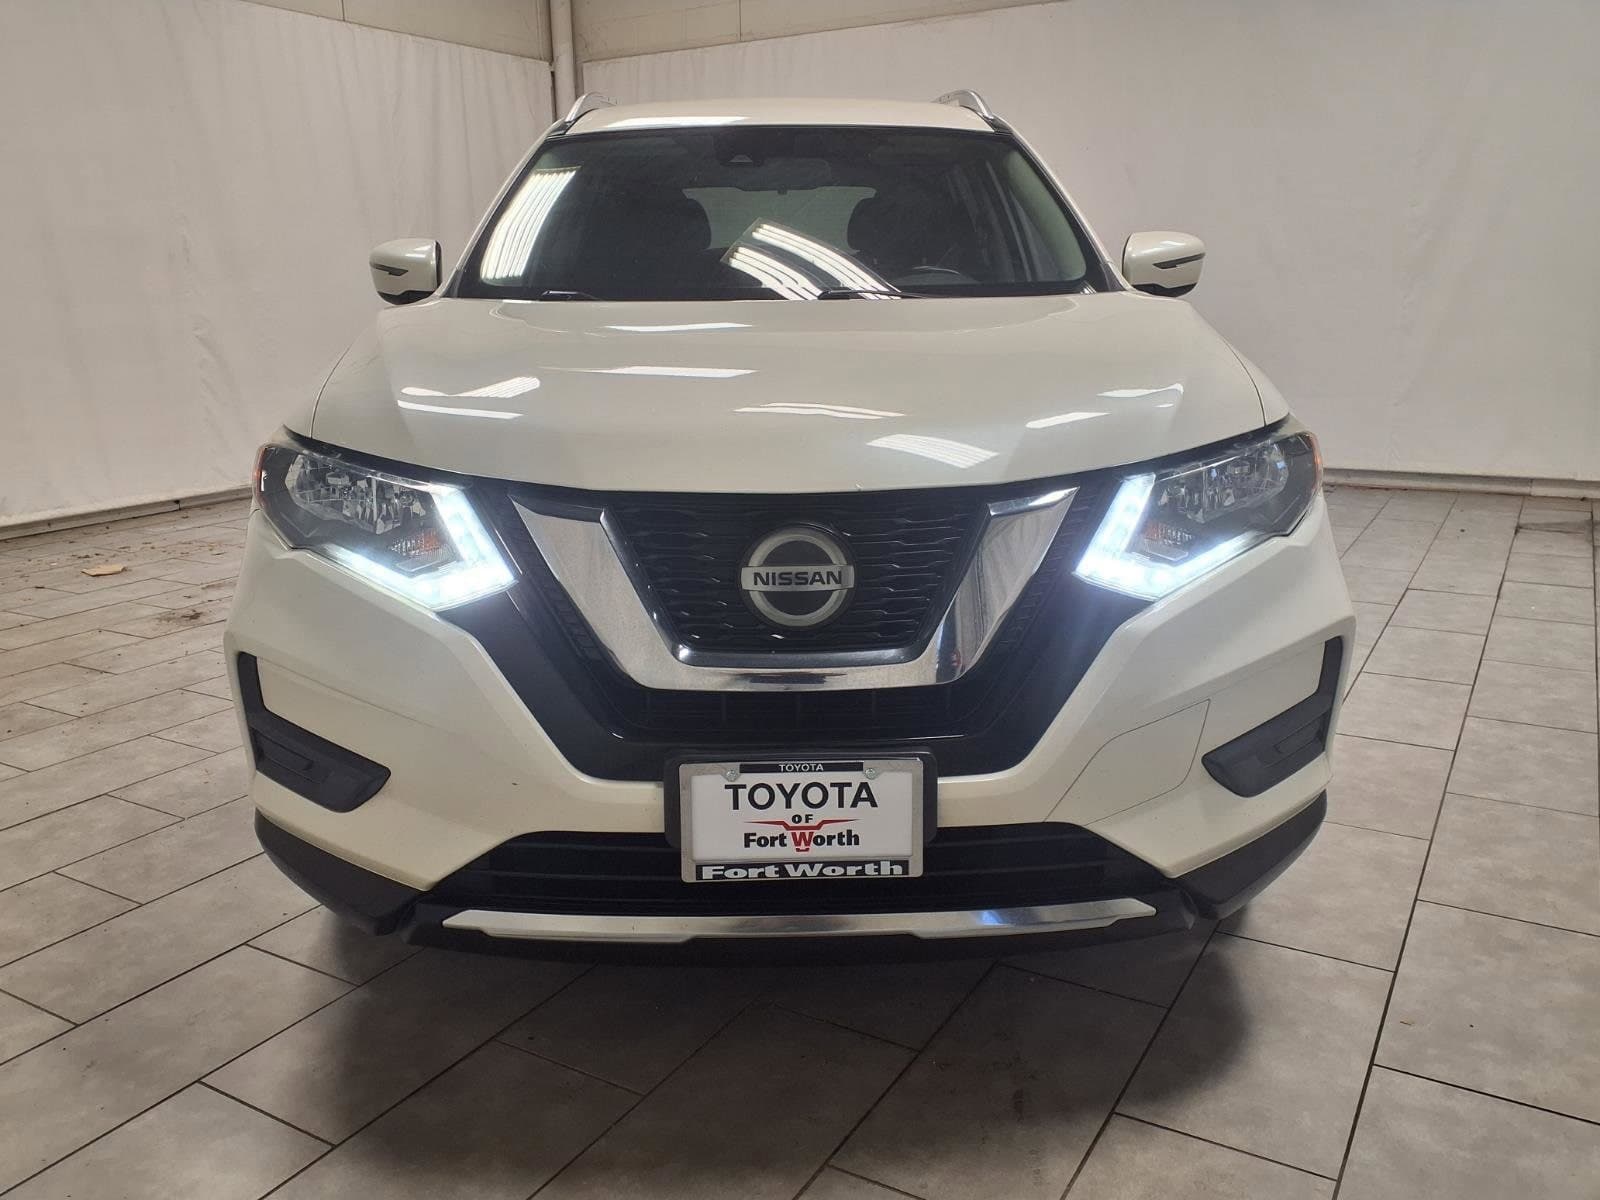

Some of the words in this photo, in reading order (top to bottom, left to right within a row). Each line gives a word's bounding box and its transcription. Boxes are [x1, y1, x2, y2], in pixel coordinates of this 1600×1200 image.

[753, 571, 842, 586] NISSAN
[779, 763, 824, 772] TOYOTA
[724, 781, 878, 811] TOYOTA
[791, 814, 814, 824] OF
[744, 832, 787, 848] Fort
[791, 829, 860, 847] Worth
[702, 864, 782, 880] Fort
[784, 860, 903, 877] Worth
